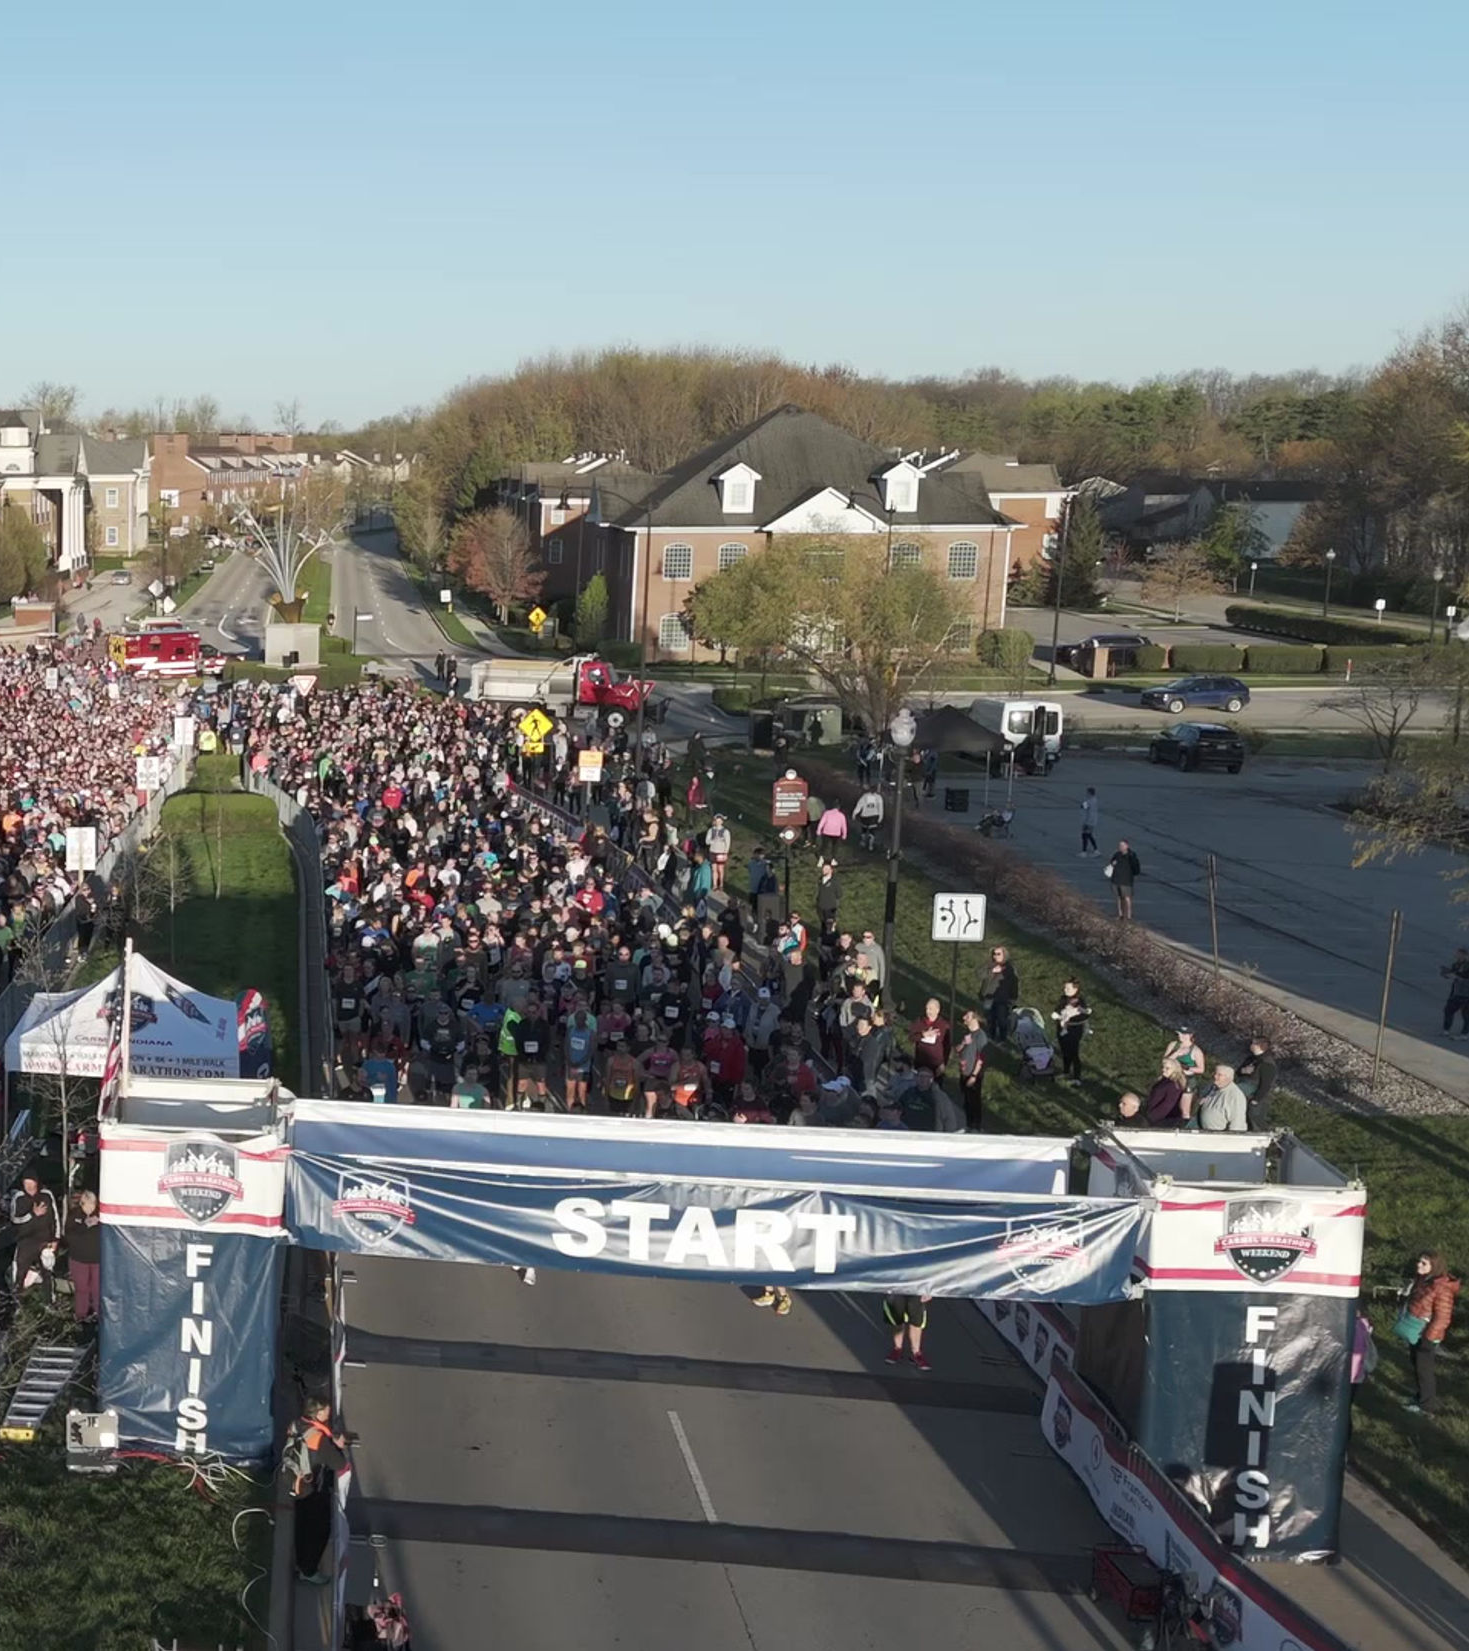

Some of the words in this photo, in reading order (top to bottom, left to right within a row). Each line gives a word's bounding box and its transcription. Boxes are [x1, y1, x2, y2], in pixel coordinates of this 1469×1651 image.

[181, 1188, 222, 1200] WEEKEND
[552, 1197, 856, 1274] START
[1222, 1237, 1258, 1247] CARMEL
[1261, 1237, 1311, 1249] MARATHON
[1241, 1249, 1291, 1259] WEEKEND
[175, 1243, 213, 1453] FINISH
[1234, 1306, 1278, 1548] FINISH
